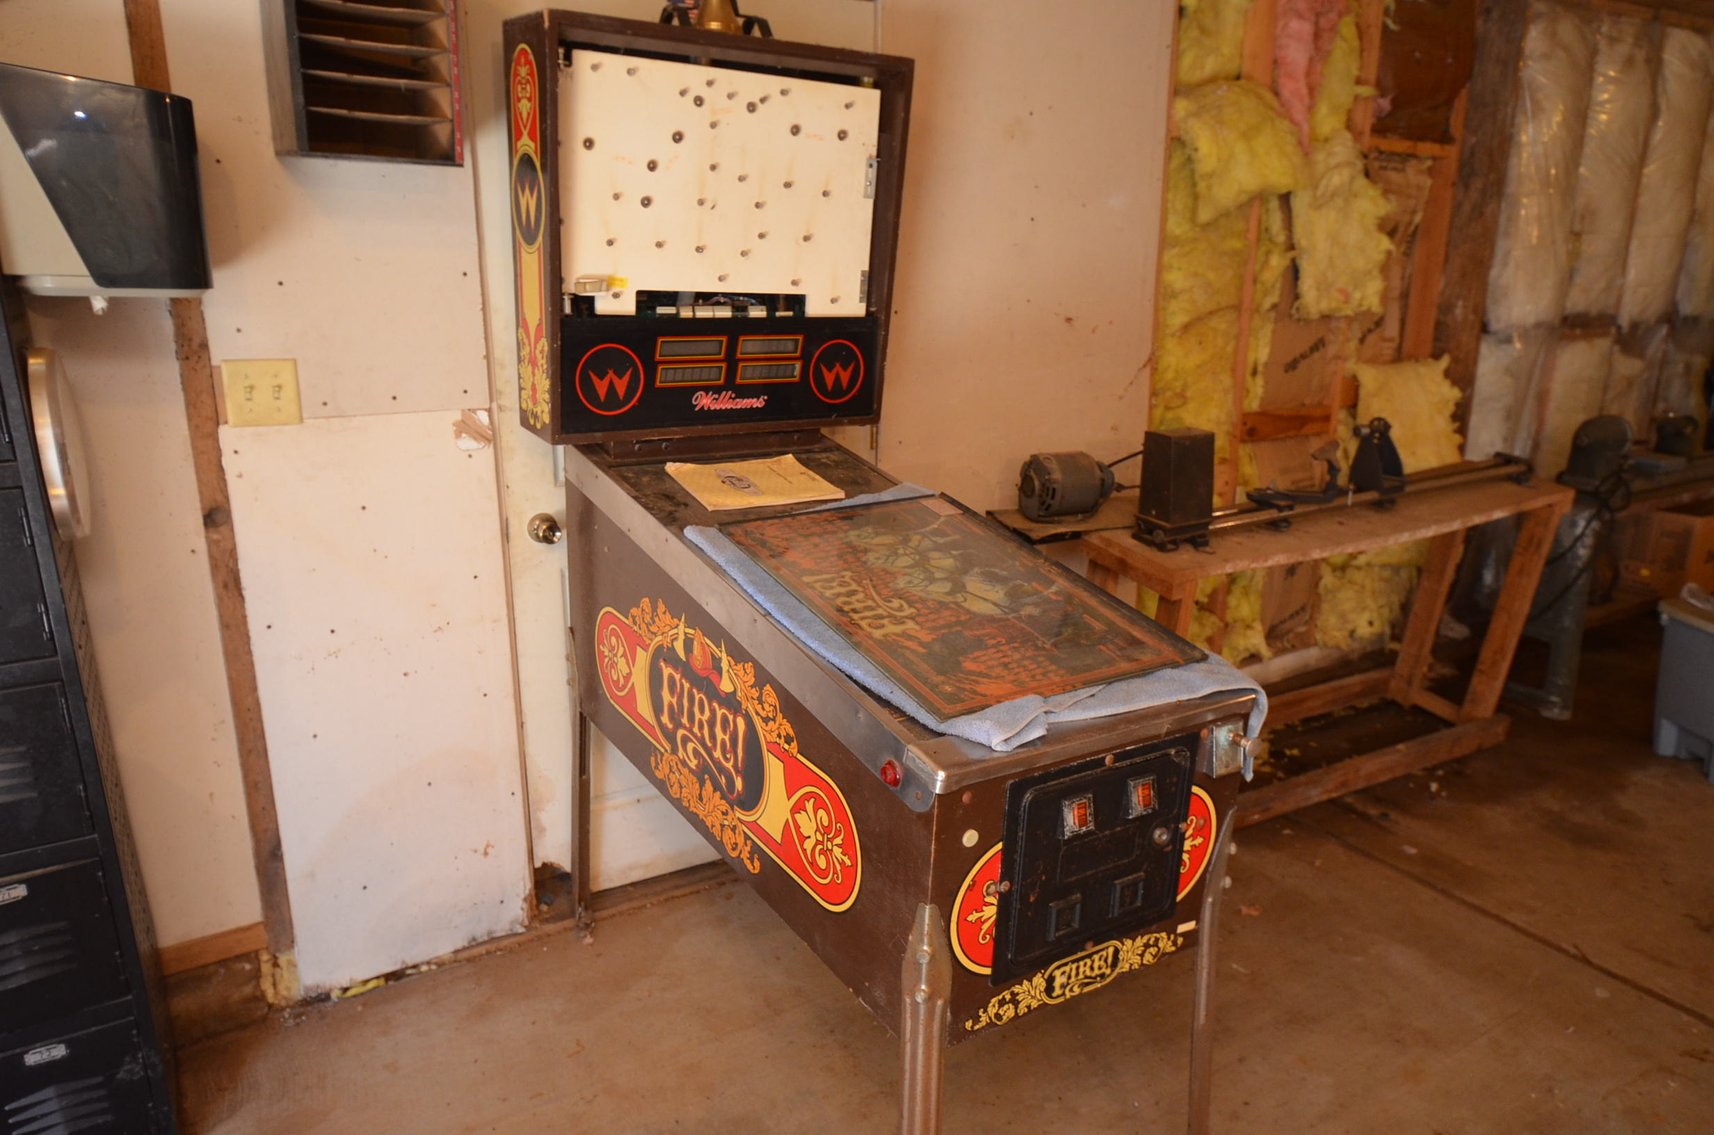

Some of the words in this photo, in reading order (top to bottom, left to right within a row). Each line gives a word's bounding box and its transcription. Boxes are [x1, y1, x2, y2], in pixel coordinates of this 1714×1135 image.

[587, 368, 634, 403] W
[819, 361, 857, 393] W
[692, 389, 768, 412] Williams
[658, 660, 746, 797] FIRE!
[1051, 945, 1116, 998] FIRE!
